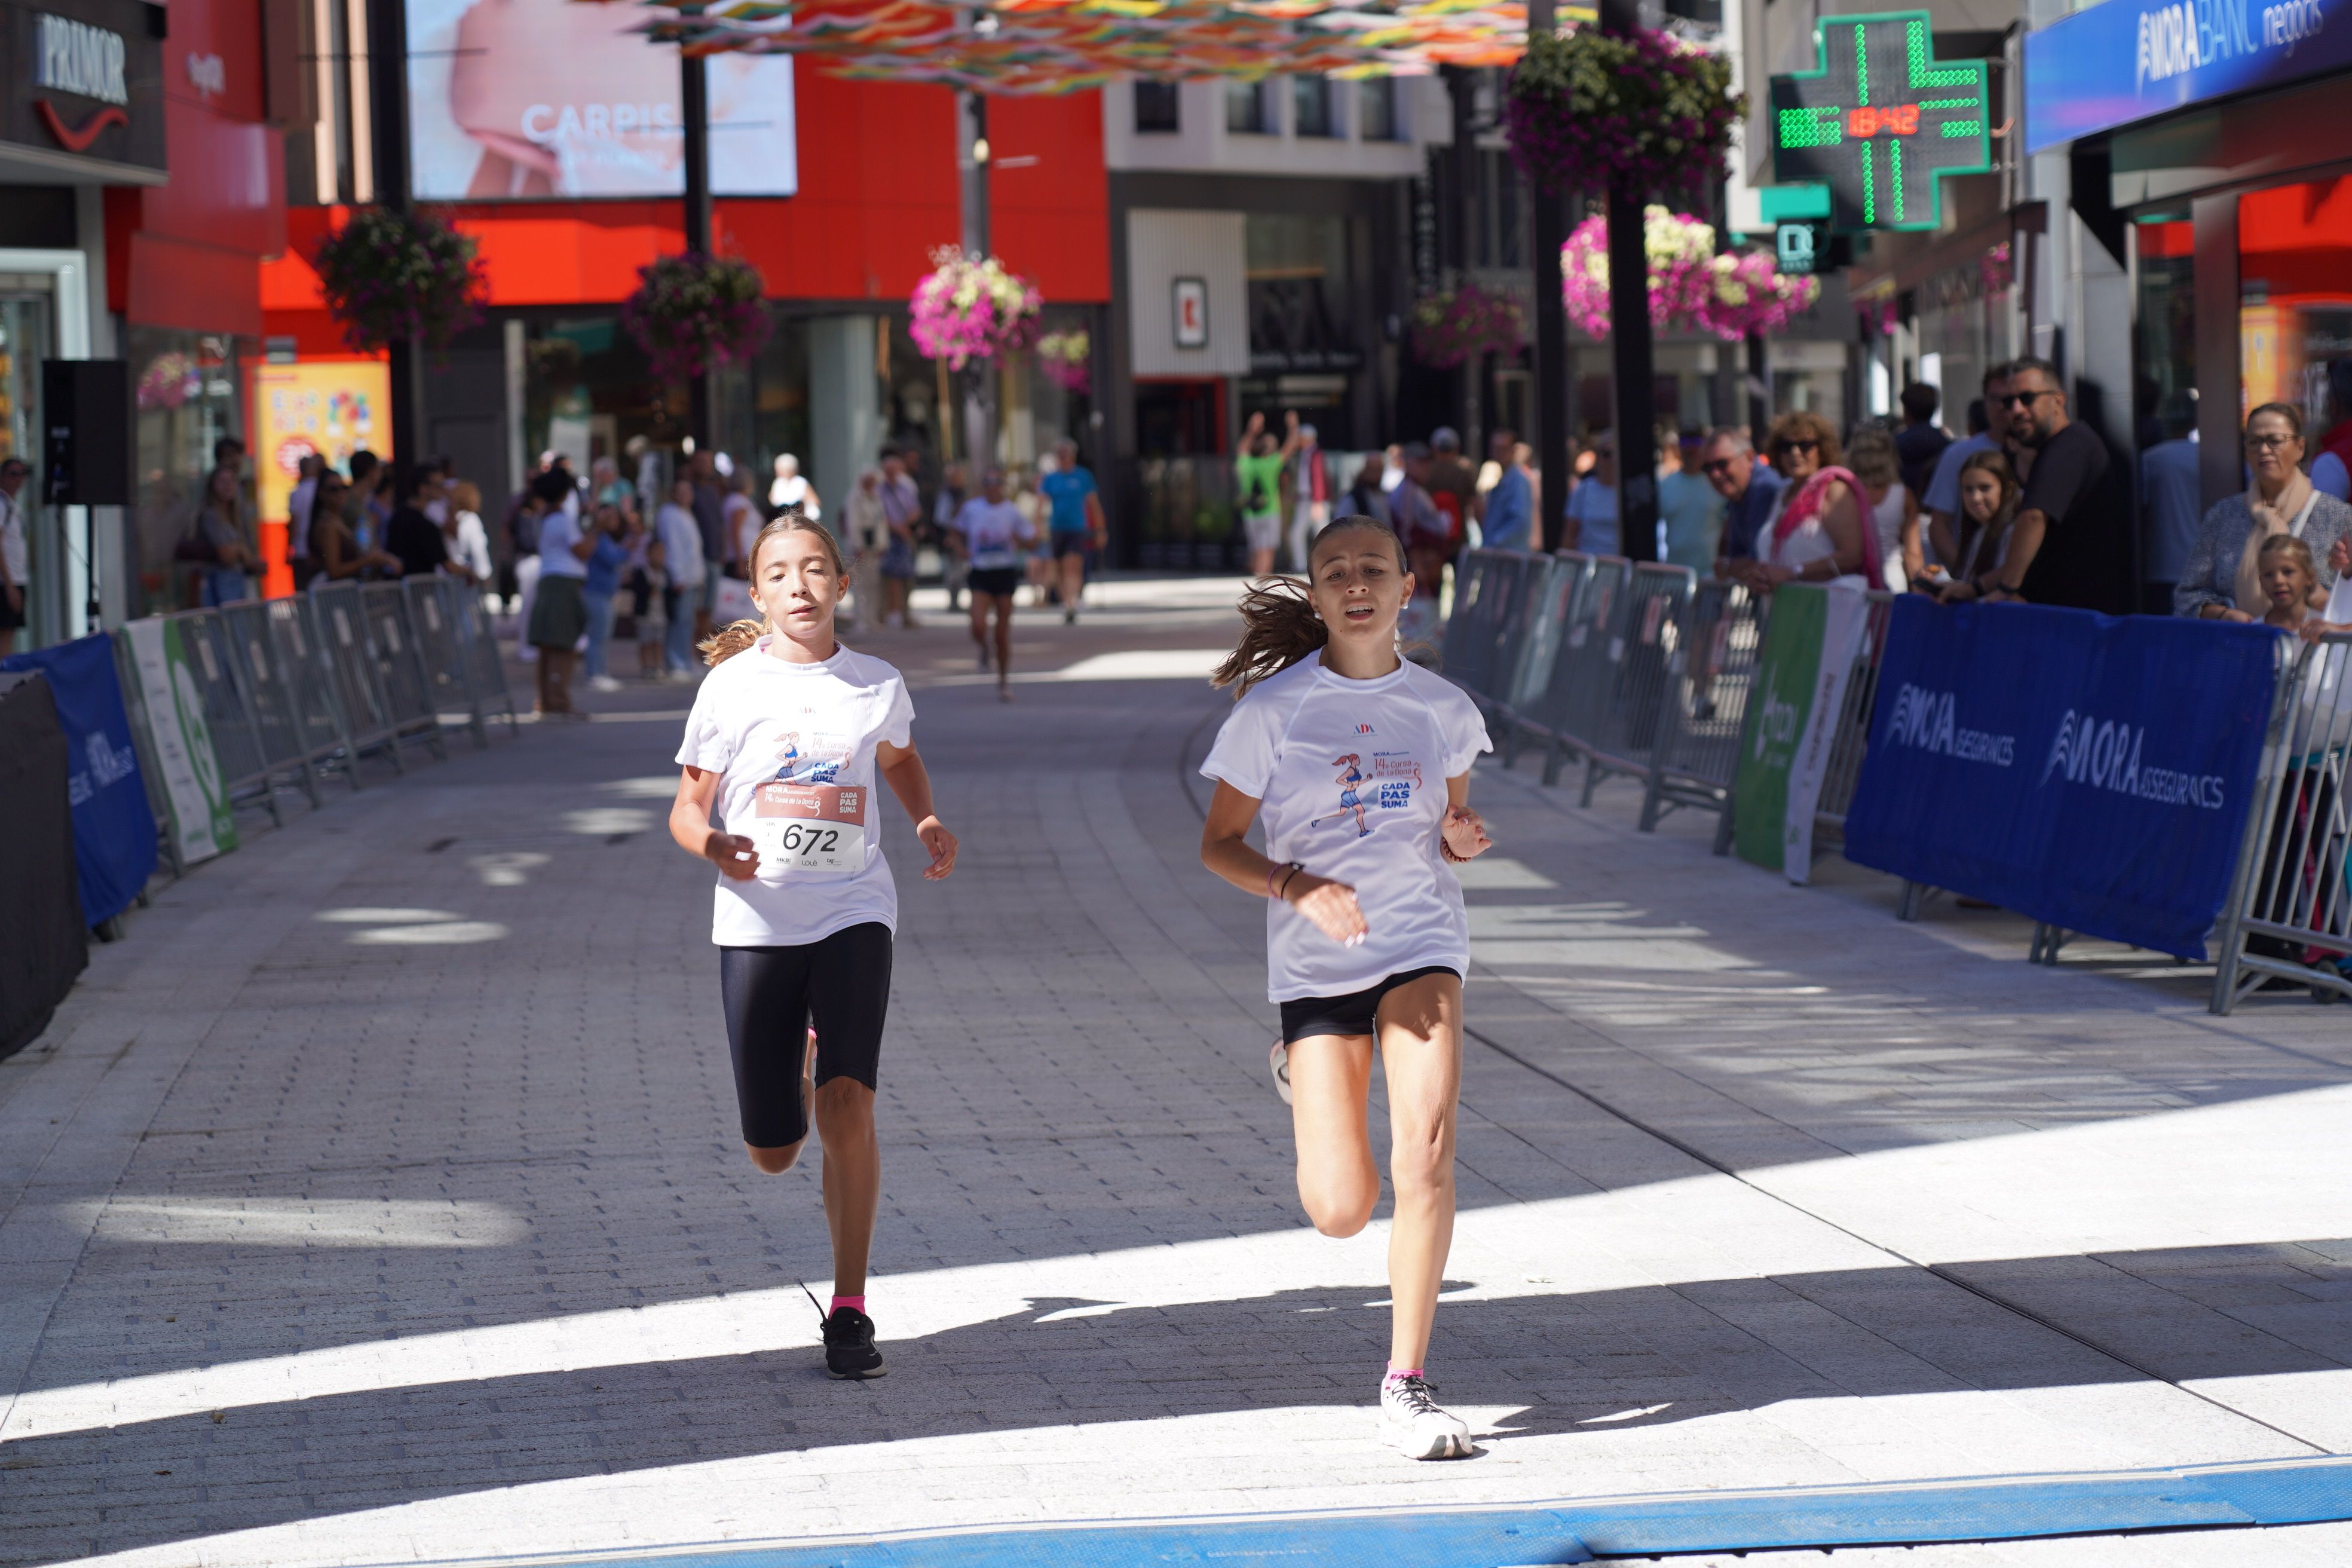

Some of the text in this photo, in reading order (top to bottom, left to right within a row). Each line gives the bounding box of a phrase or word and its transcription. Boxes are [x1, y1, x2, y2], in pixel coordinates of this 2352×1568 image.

[39, 13, 127, 106] PRIMOR
[1353, 724, 1374, 734] ADA
[1391, 760, 1411, 768] Cursa
[765, 785, 788, 794] MORA
[1381, 791, 1410, 799] PAS
[1381, 800, 1408, 808] SUMA
[783, 824, 838, 856] 672
